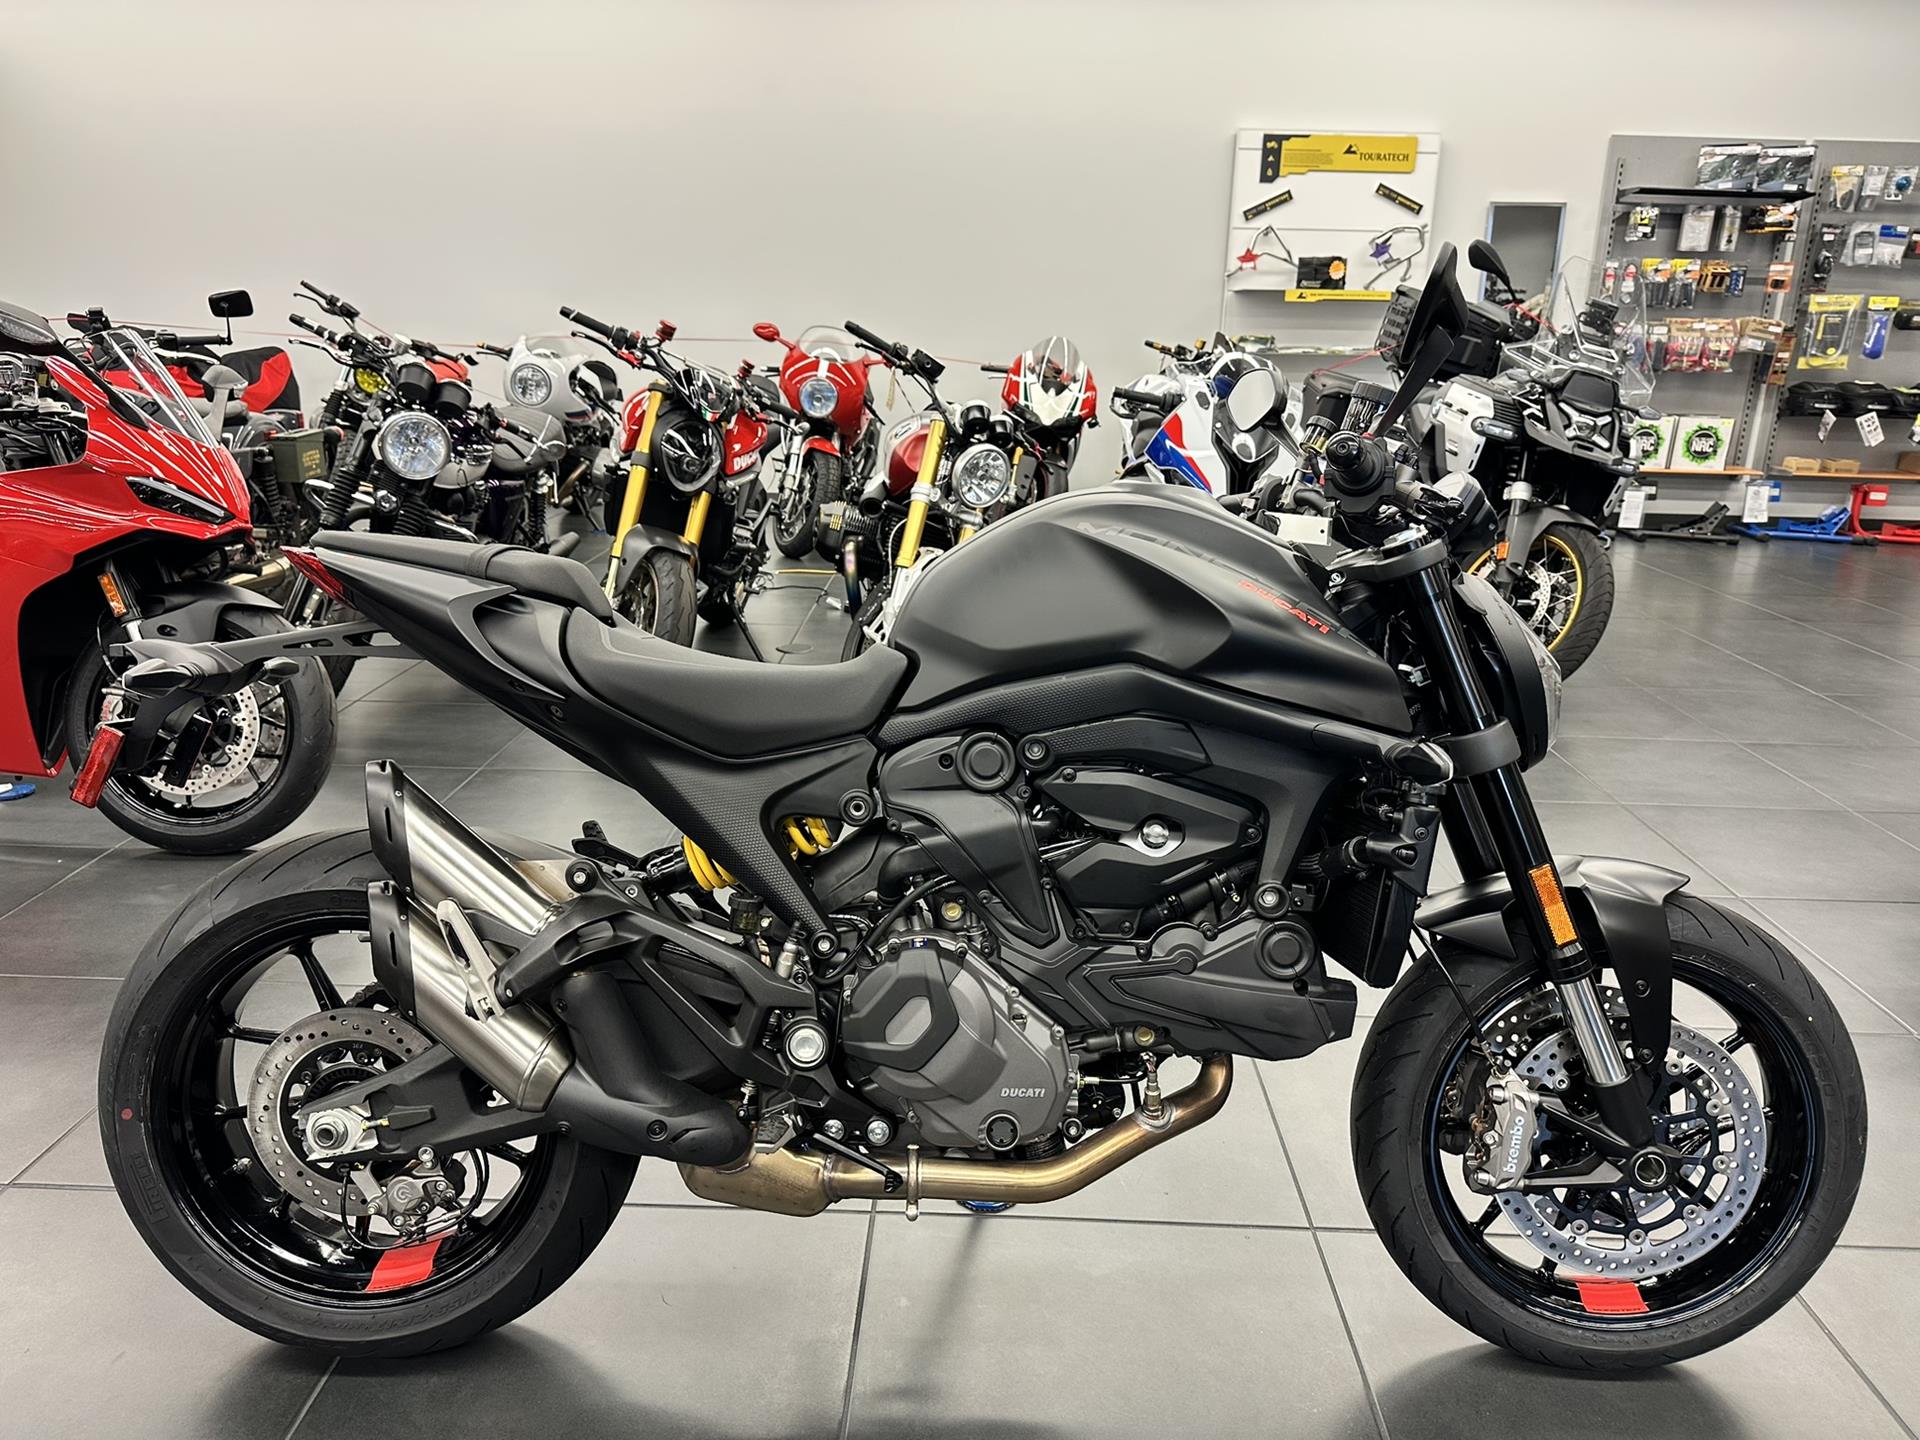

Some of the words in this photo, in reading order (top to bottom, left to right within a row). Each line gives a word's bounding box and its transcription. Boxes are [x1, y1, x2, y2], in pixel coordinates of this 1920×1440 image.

[1359, 152, 1409, 162] TOURATECH
[1238, 580, 1330, 634] DUCATI
[1001, 1088, 1046, 1097] DUCATI
[1502, 1115, 1526, 1174] brembo
